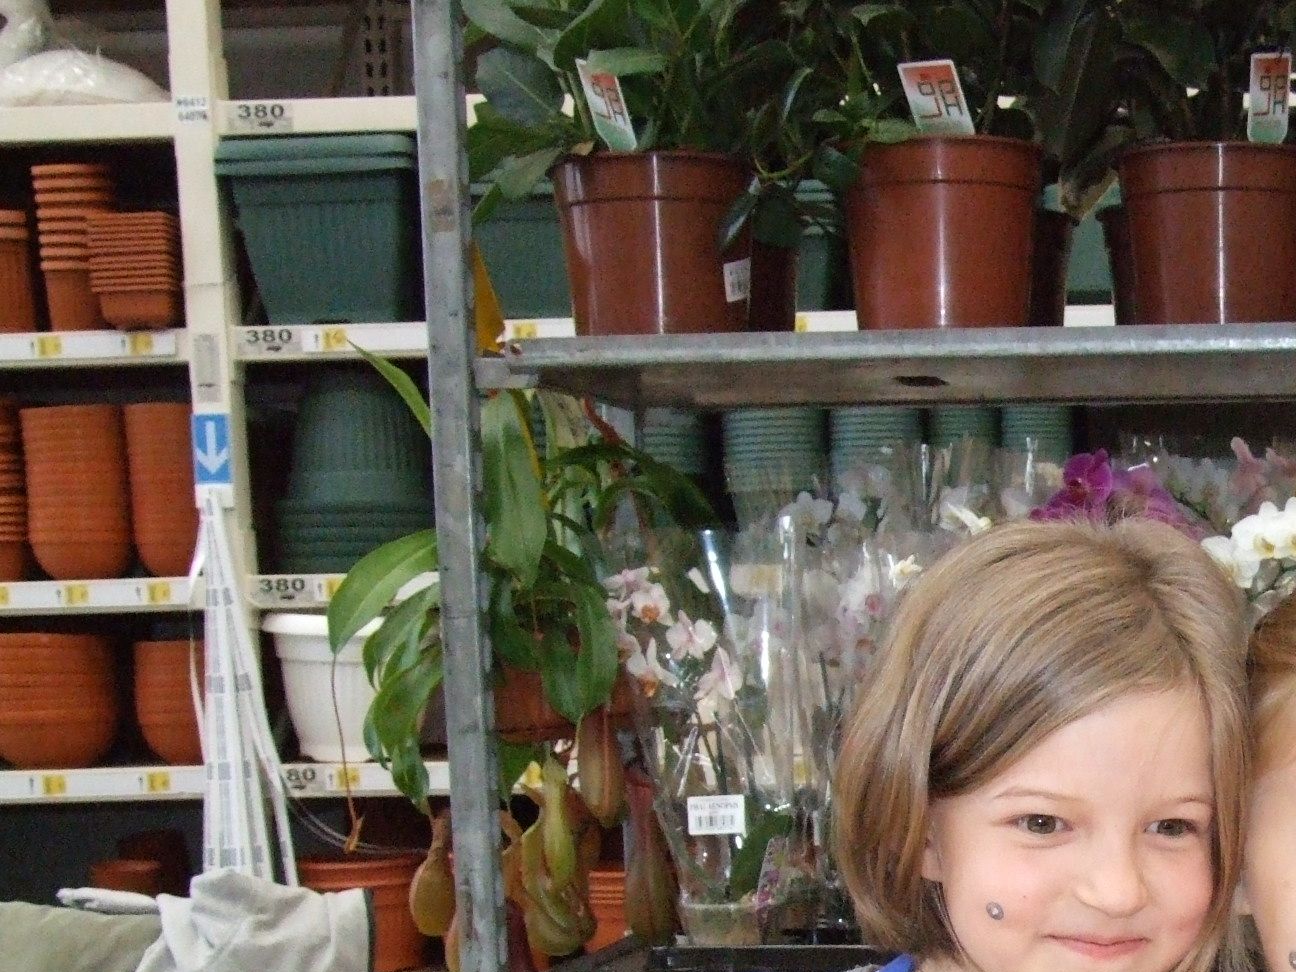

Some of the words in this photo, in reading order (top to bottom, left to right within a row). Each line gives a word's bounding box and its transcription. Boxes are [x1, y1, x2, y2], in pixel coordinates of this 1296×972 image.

[238, 104, 284, 119] 380
[246, 329, 292, 344] 380
[260, 578, 305, 593] 380
[285, 768, 316, 781] 80
